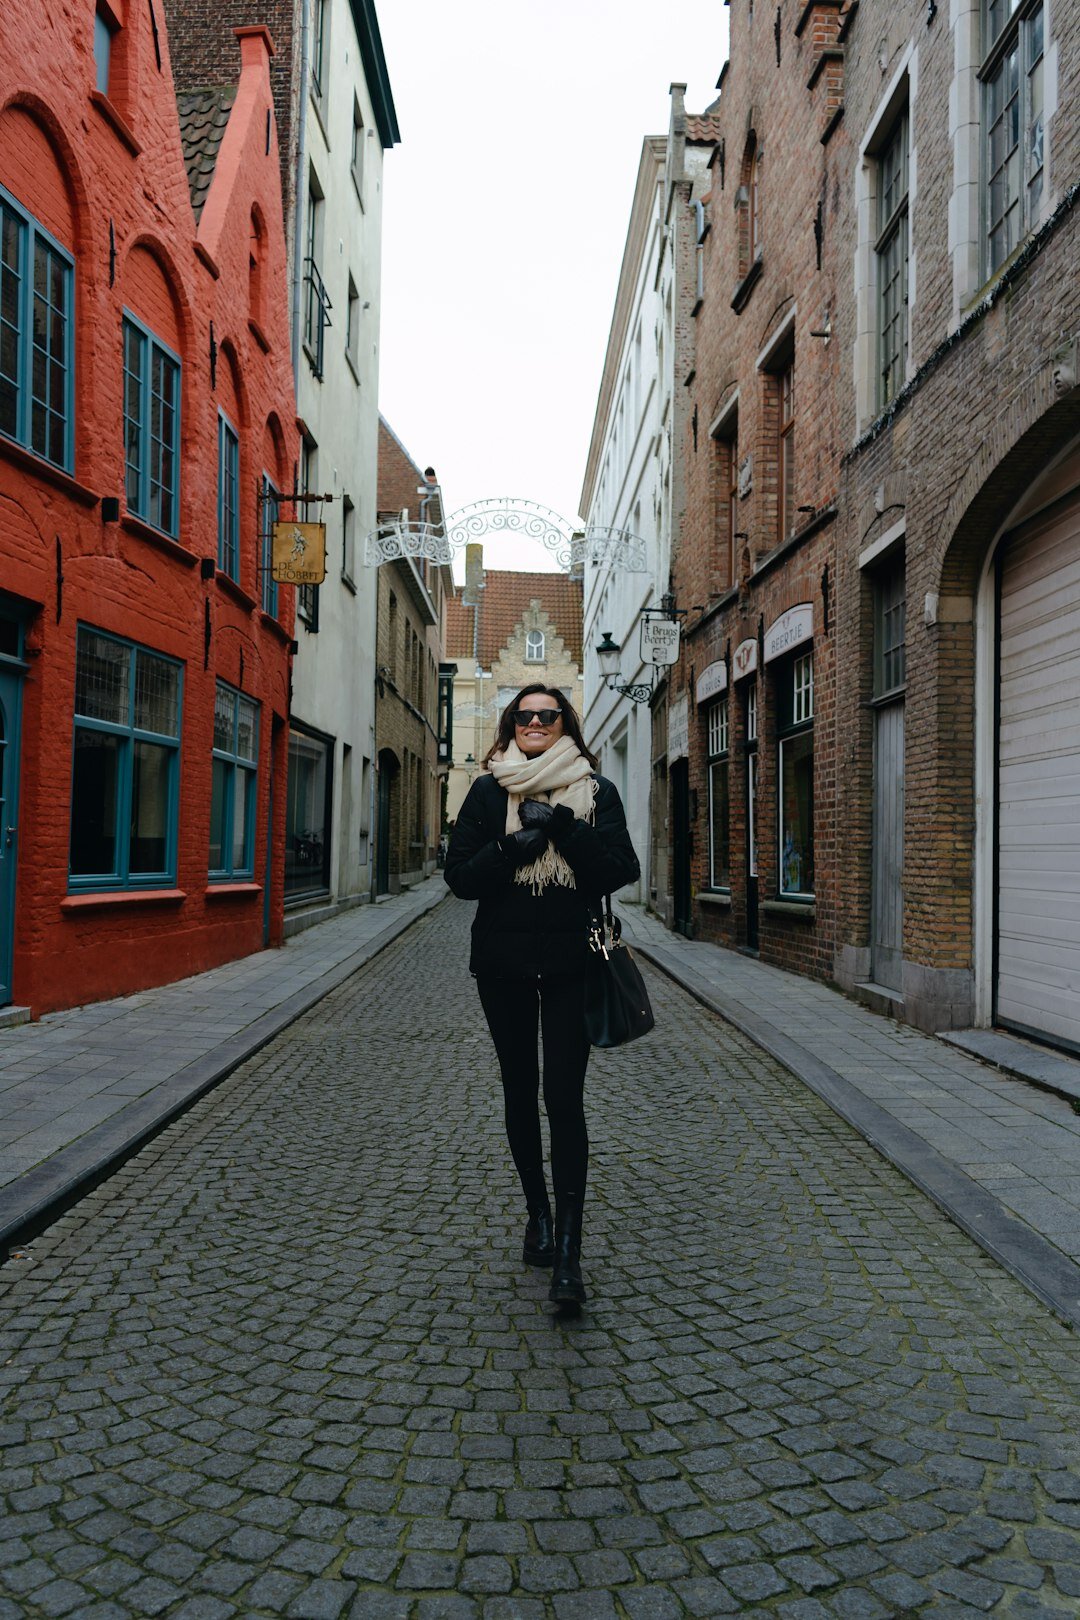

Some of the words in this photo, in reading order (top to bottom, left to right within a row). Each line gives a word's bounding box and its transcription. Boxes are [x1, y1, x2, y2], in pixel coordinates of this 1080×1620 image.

[278, 562, 293, 571] DE
[278, 570, 320, 580] HOBBIT
[652, 625, 678, 637] Brugs
[771, 623, 802, 654] BEERTJE
